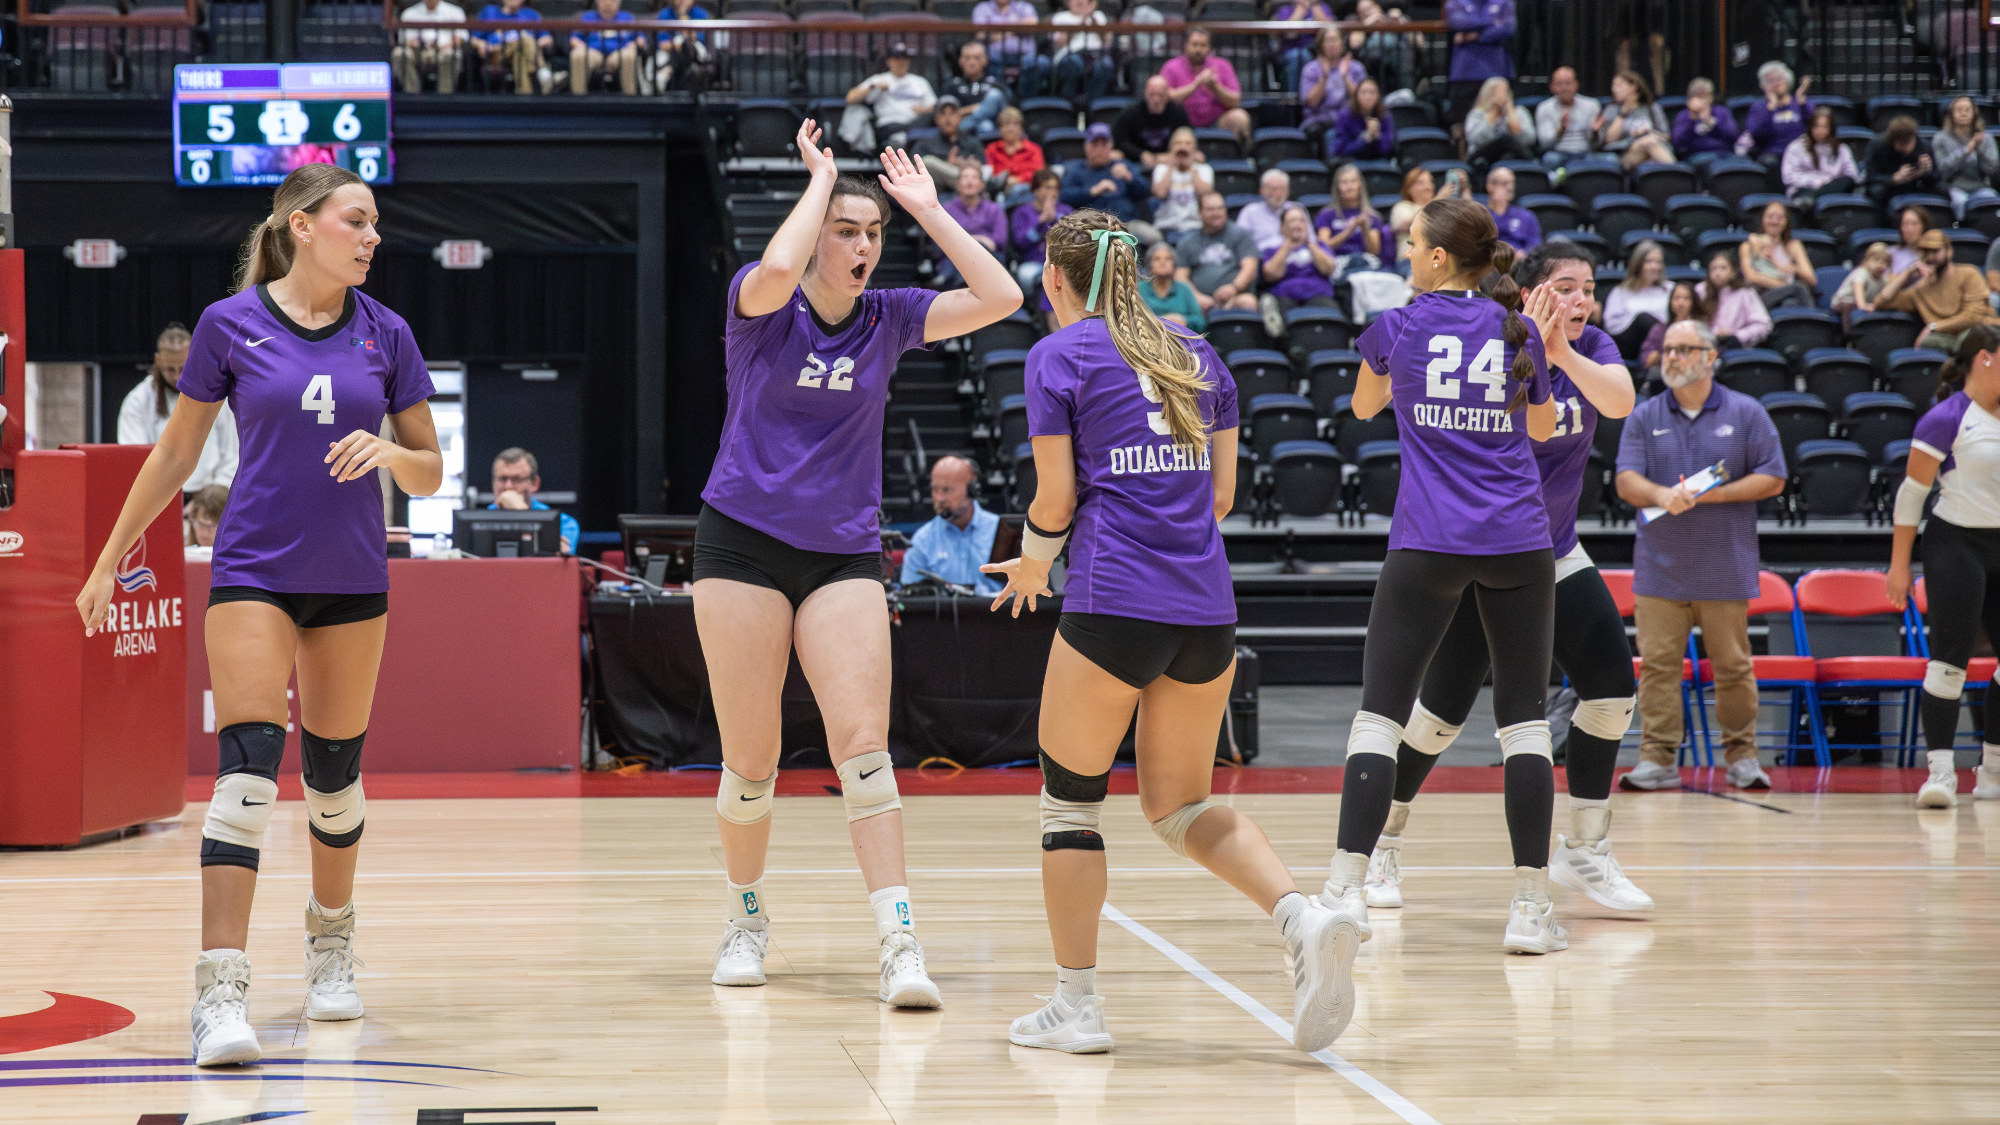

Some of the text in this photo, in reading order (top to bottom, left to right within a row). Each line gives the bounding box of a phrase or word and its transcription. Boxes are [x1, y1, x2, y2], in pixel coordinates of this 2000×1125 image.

[207, 104, 235, 142] 5
[278, 118, 290, 138] 1
[333, 104, 361, 141] 6
[191, 160, 211, 184] 0
[359, 157, 379, 182] 0
[81, 241, 110, 265] EXIT
[449, 241, 476, 266] EXIT
[797, 352, 855, 391] 22
[1426, 335, 1506, 402] 24
[302, 375, 335, 424] 4
[1413, 403, 1513, 433] OUACHITA
[114, 631, 157, 657] ARENA
